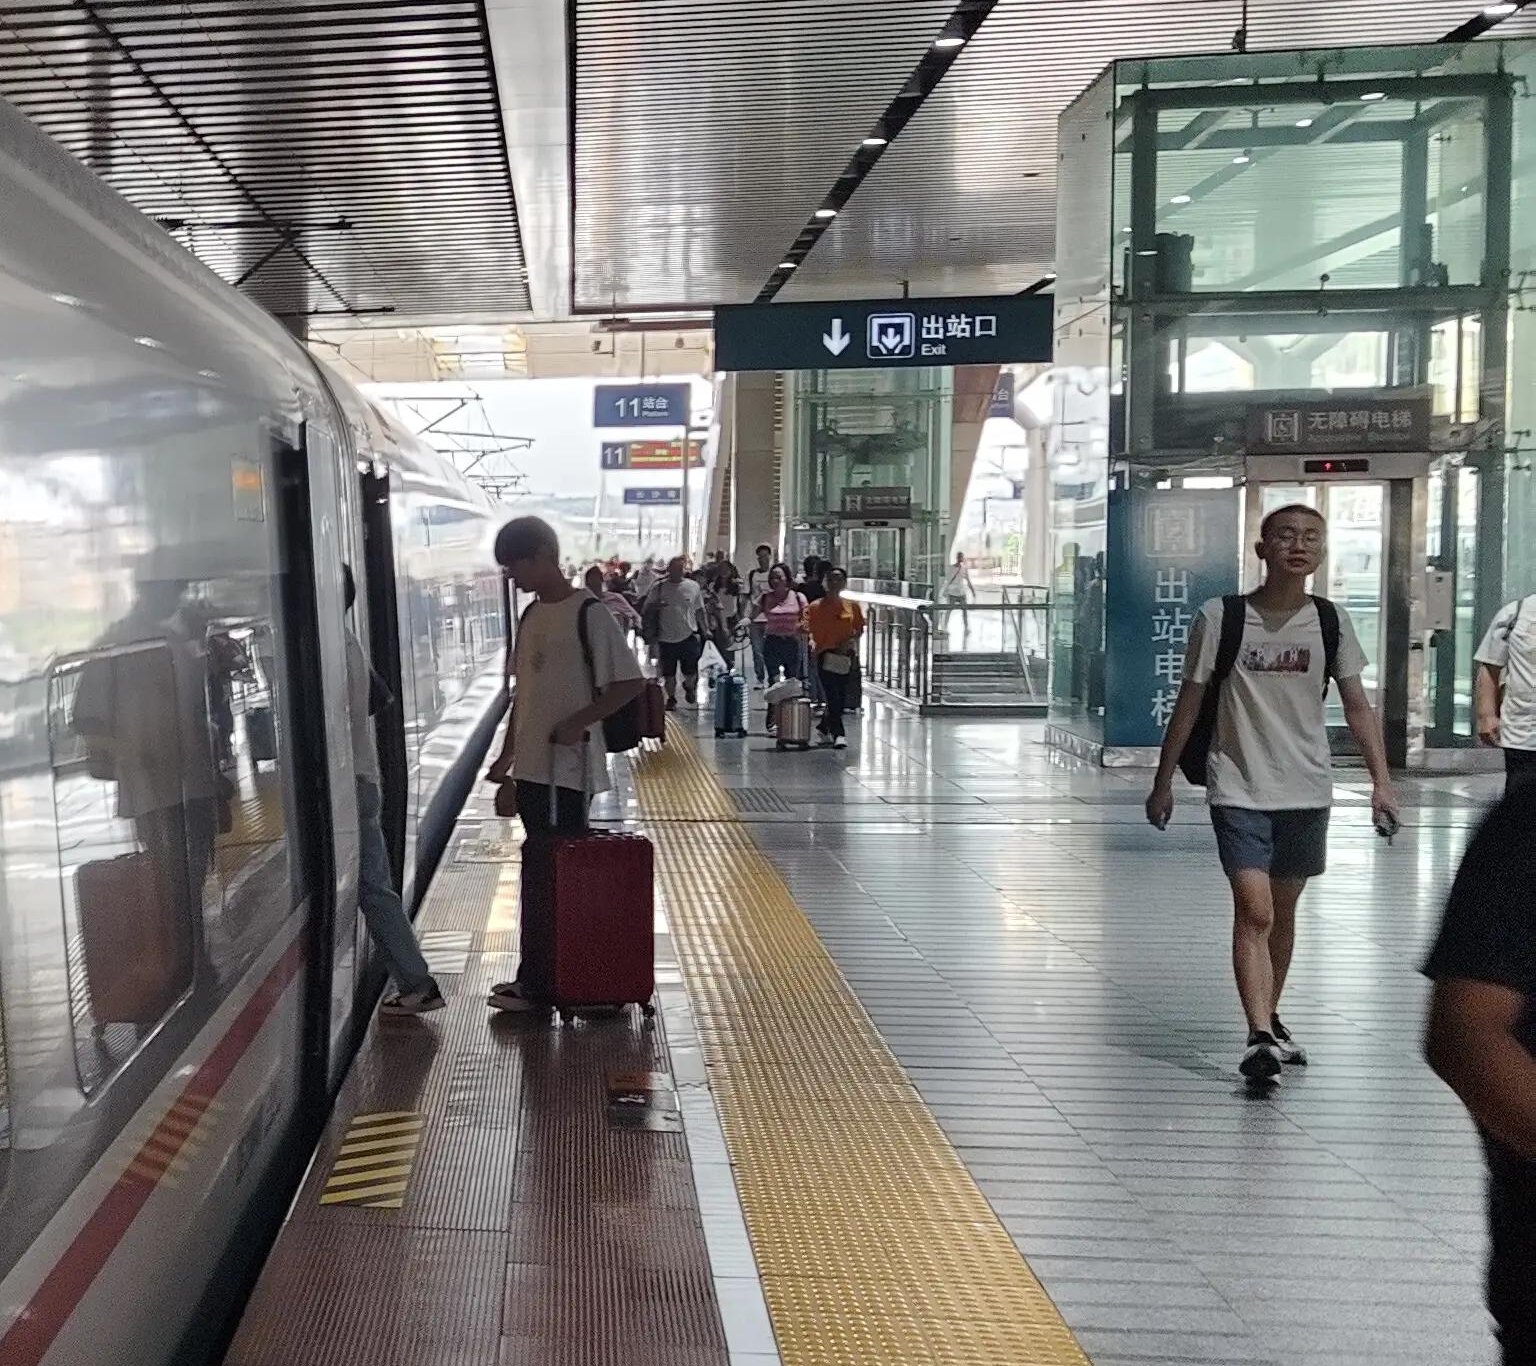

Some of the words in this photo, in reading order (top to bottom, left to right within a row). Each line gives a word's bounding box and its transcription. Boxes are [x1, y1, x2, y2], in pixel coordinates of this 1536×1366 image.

[921, 314, 997, 340] 出站口
[921, 343, 947, 357] Exit
[1307, 409, 1412, 431] 无障碍电梯
[604, 447, 625, 465] 11
